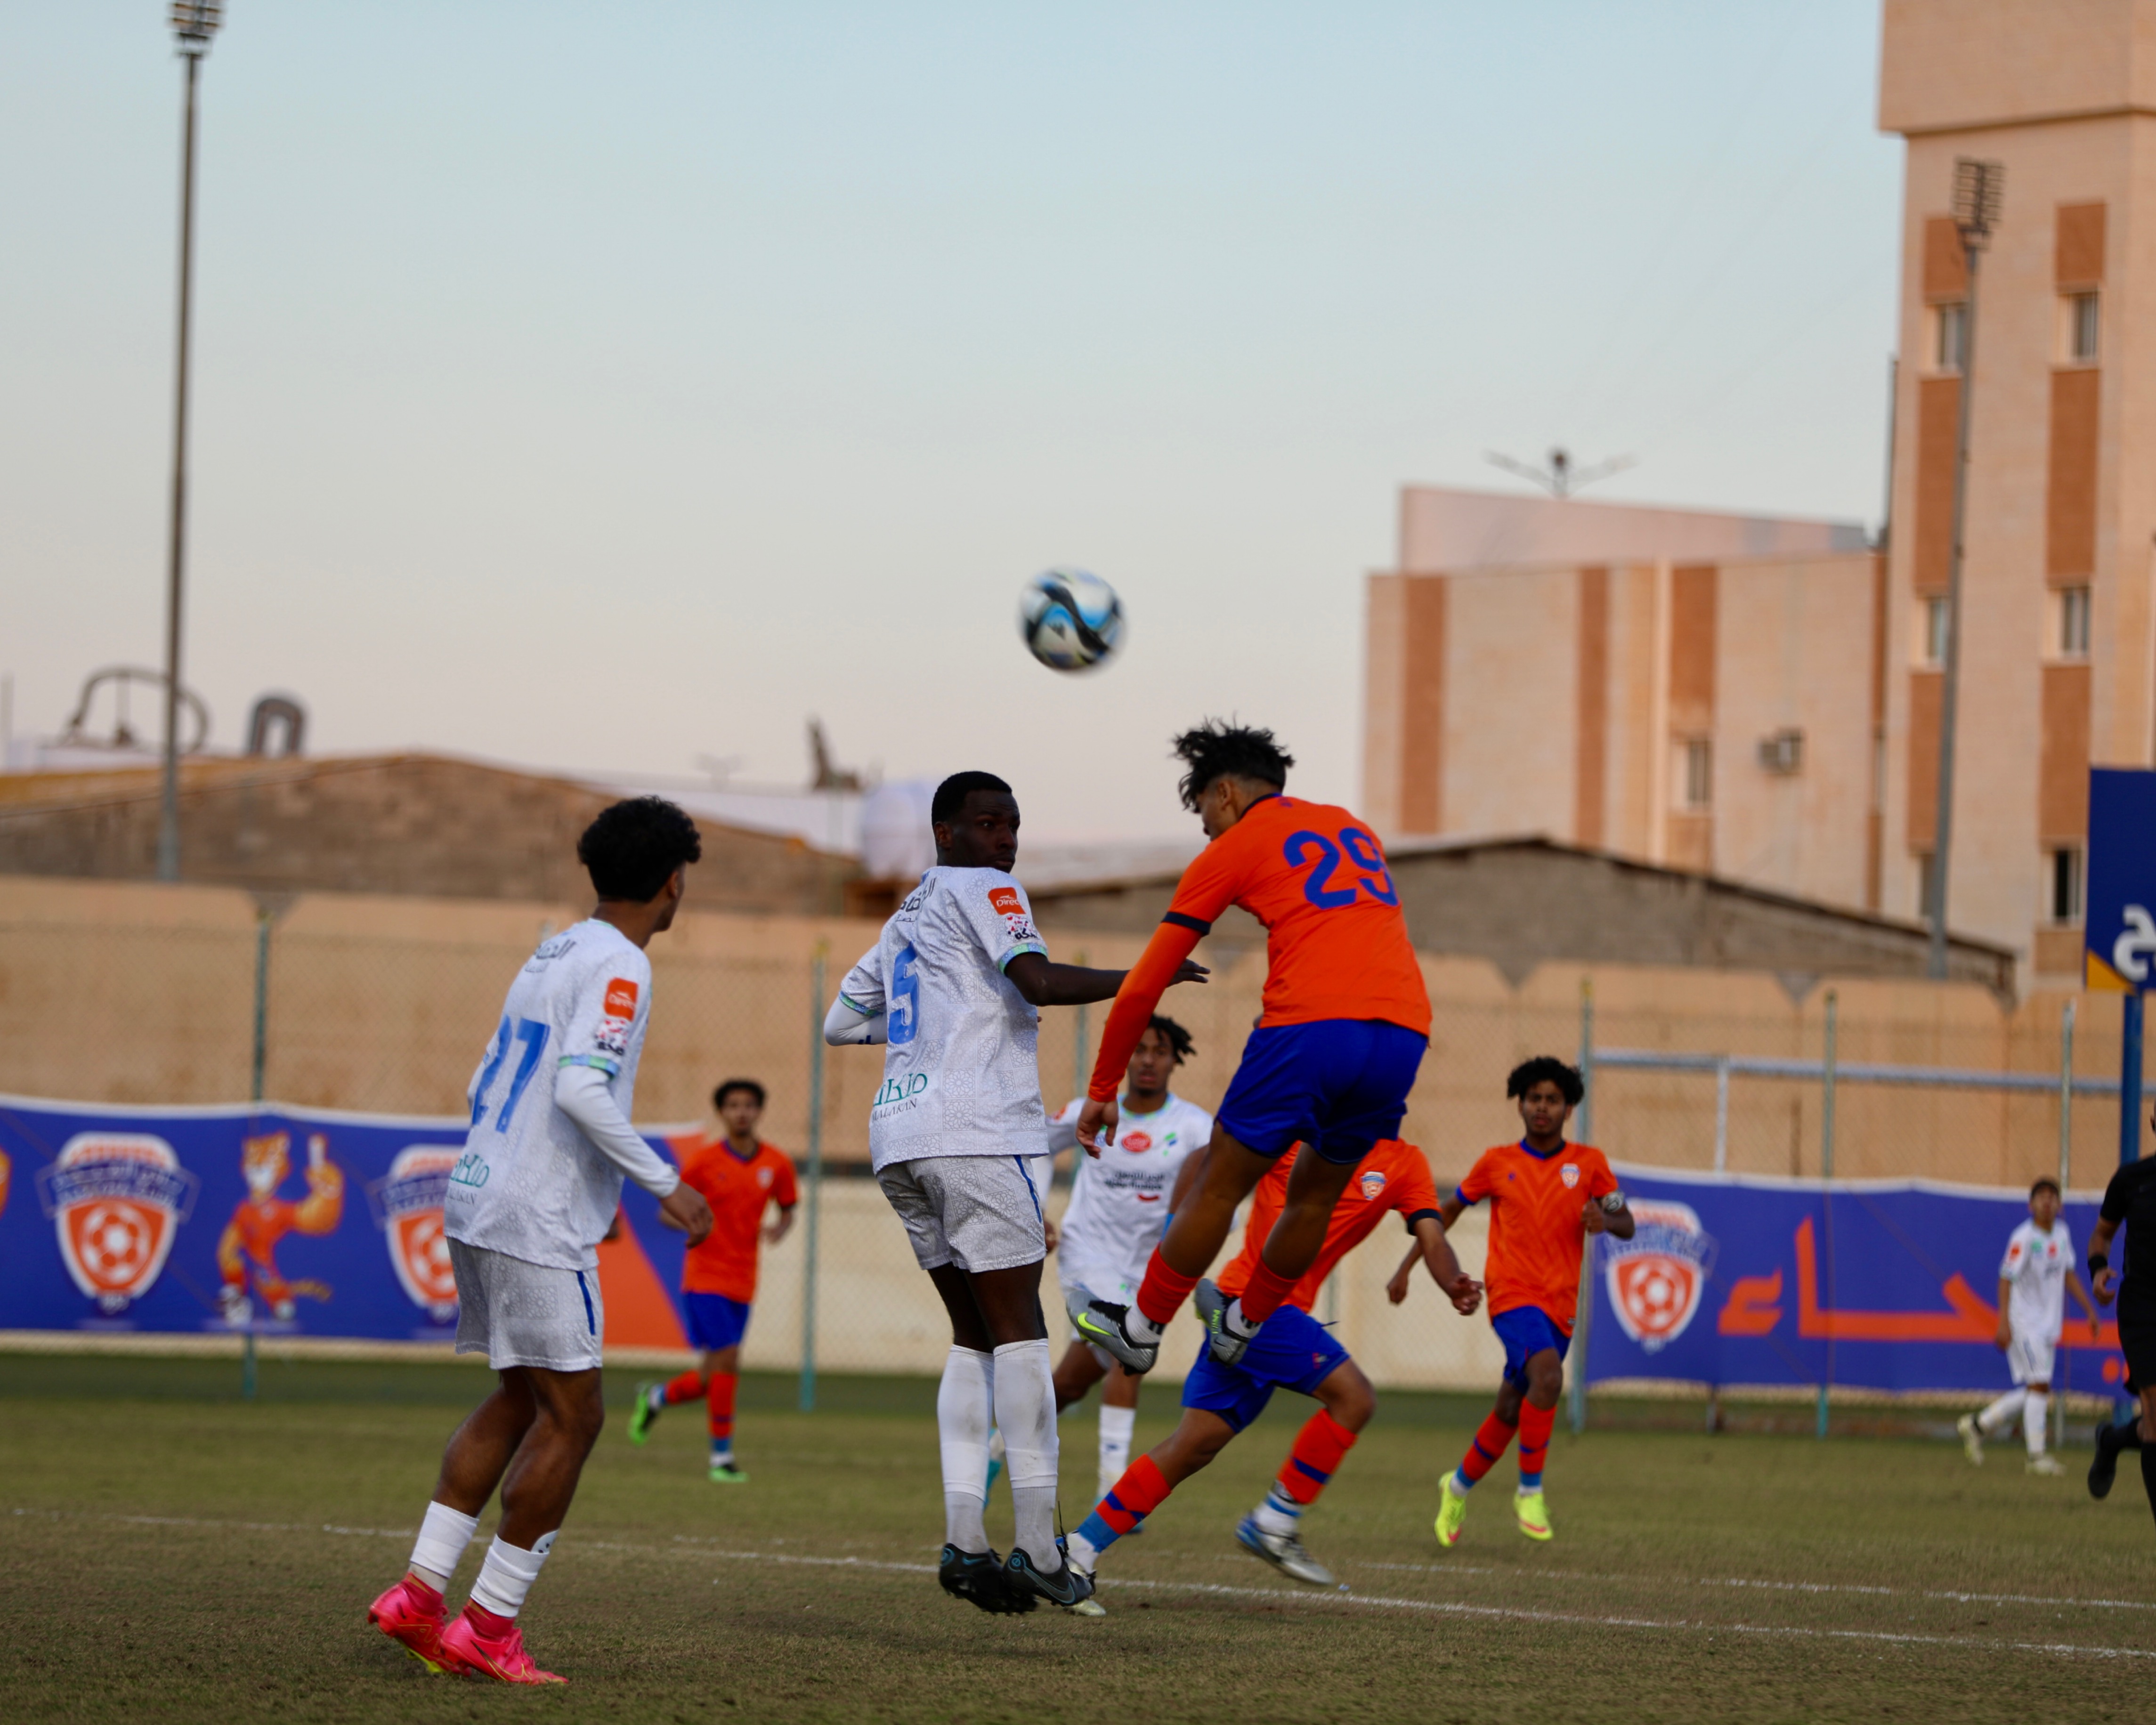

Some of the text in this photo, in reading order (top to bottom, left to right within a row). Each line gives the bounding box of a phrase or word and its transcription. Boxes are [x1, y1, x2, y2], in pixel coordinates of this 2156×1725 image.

[997, 898, 1020, 907] Direc
[1283, 827, 1399, 909] 29
[888, 941, 919, 1045] 5
[472, 1015, 551, 1134] 27
[872, 1098, 917, 1122] MALAKAN
